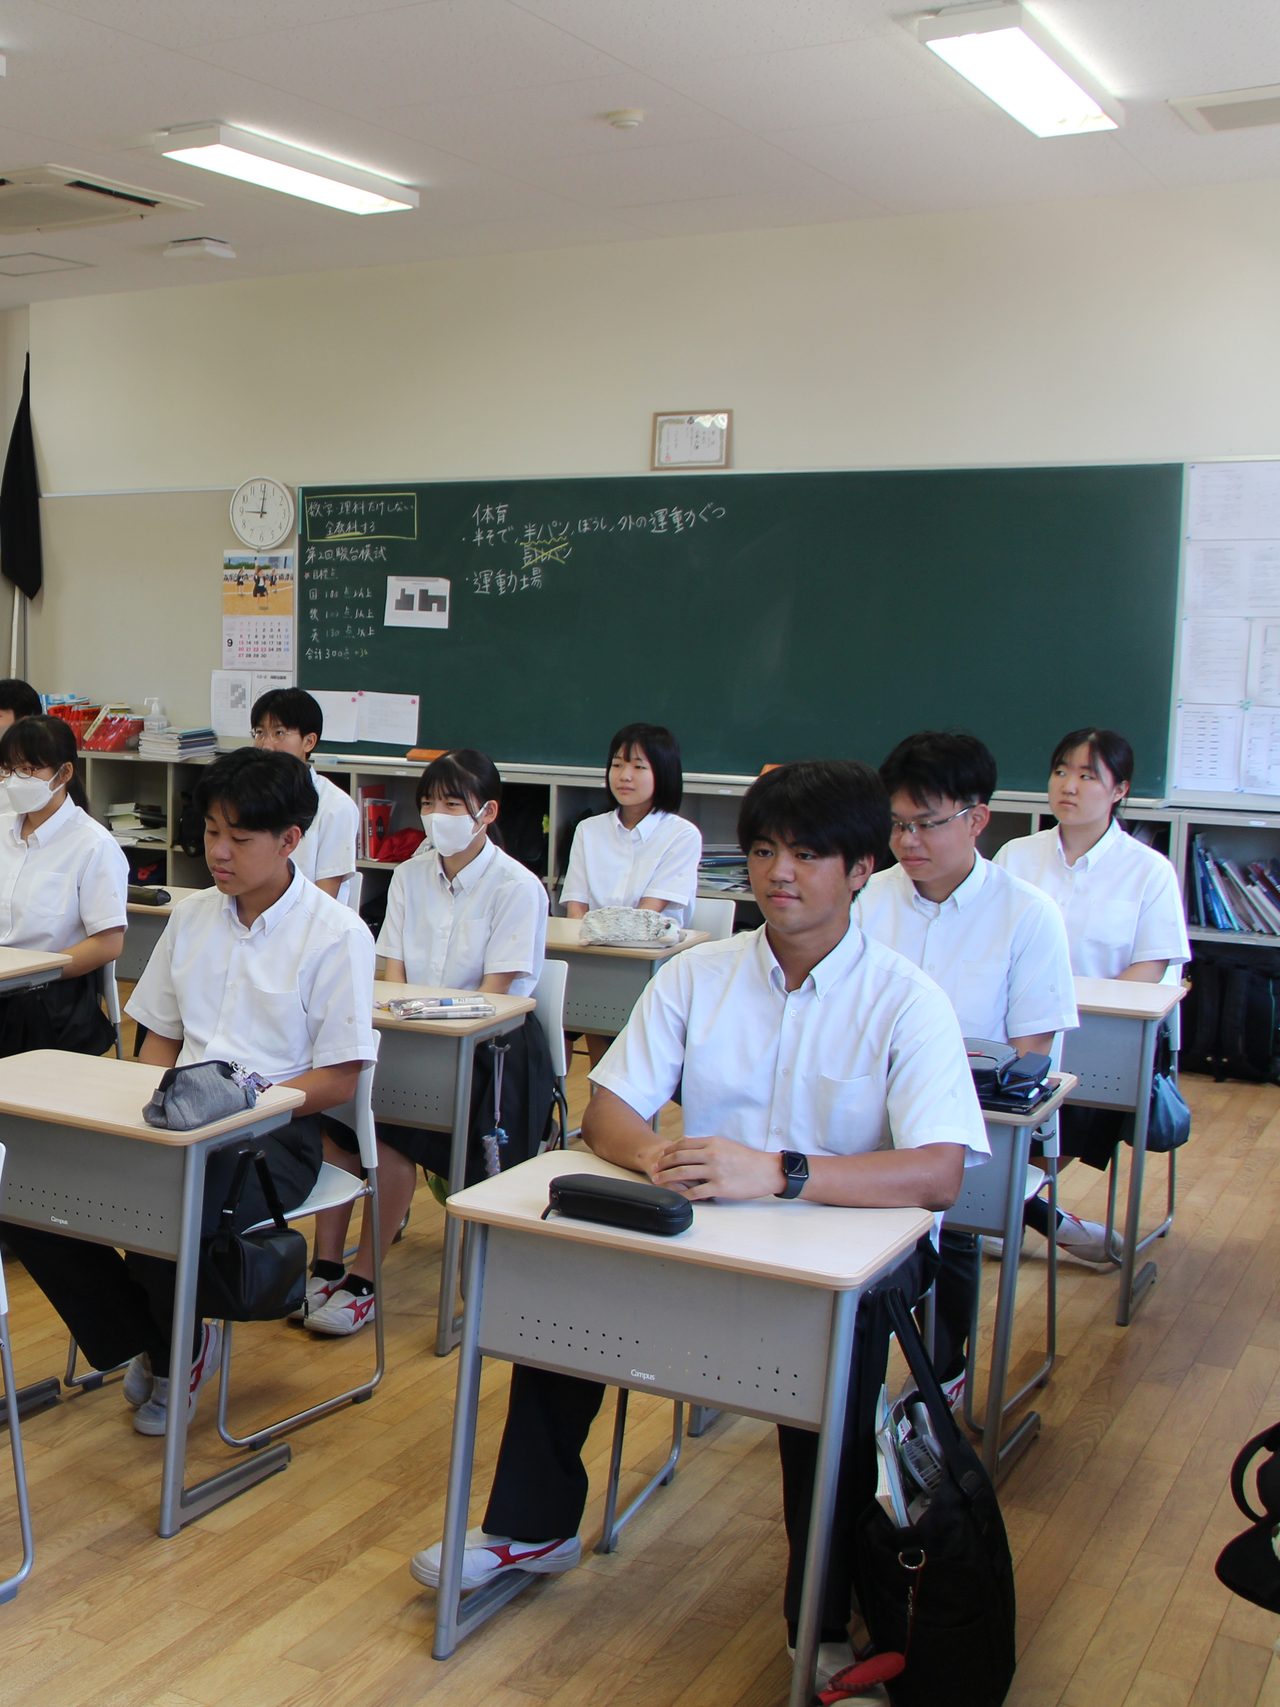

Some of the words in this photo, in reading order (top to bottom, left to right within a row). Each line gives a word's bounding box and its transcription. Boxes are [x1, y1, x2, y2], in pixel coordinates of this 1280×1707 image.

[472, 503, 509, 526] 体育
[473, 568, 543, 595] 運動場
[226, 638, 233, 647] 9
[630, 1369, 656, 1381] Campus
